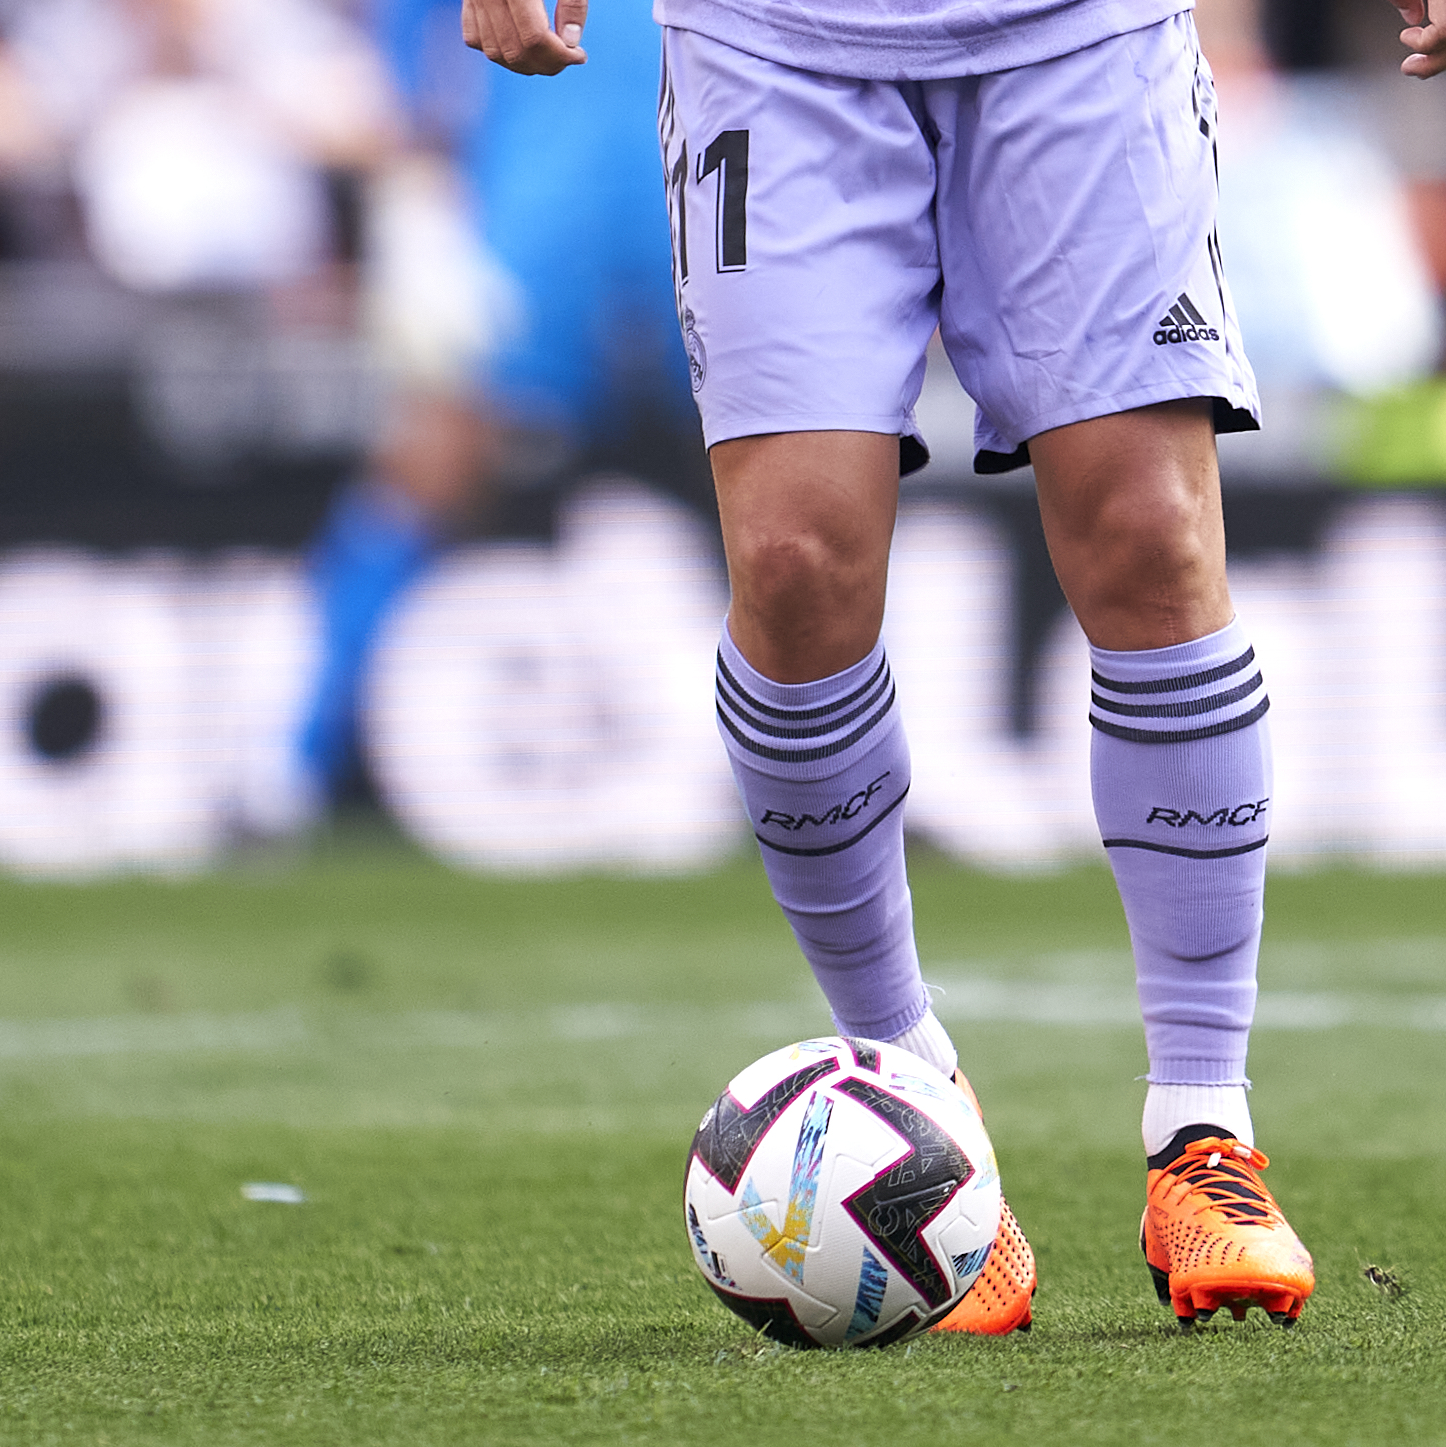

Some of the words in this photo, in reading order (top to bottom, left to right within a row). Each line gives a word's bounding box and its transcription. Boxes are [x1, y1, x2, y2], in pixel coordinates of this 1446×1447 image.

[1153, 324, 1220, 346] adidas
[760, 770, 890, 831] RMCF
[1146, 797, 1269, 828] RMCF
